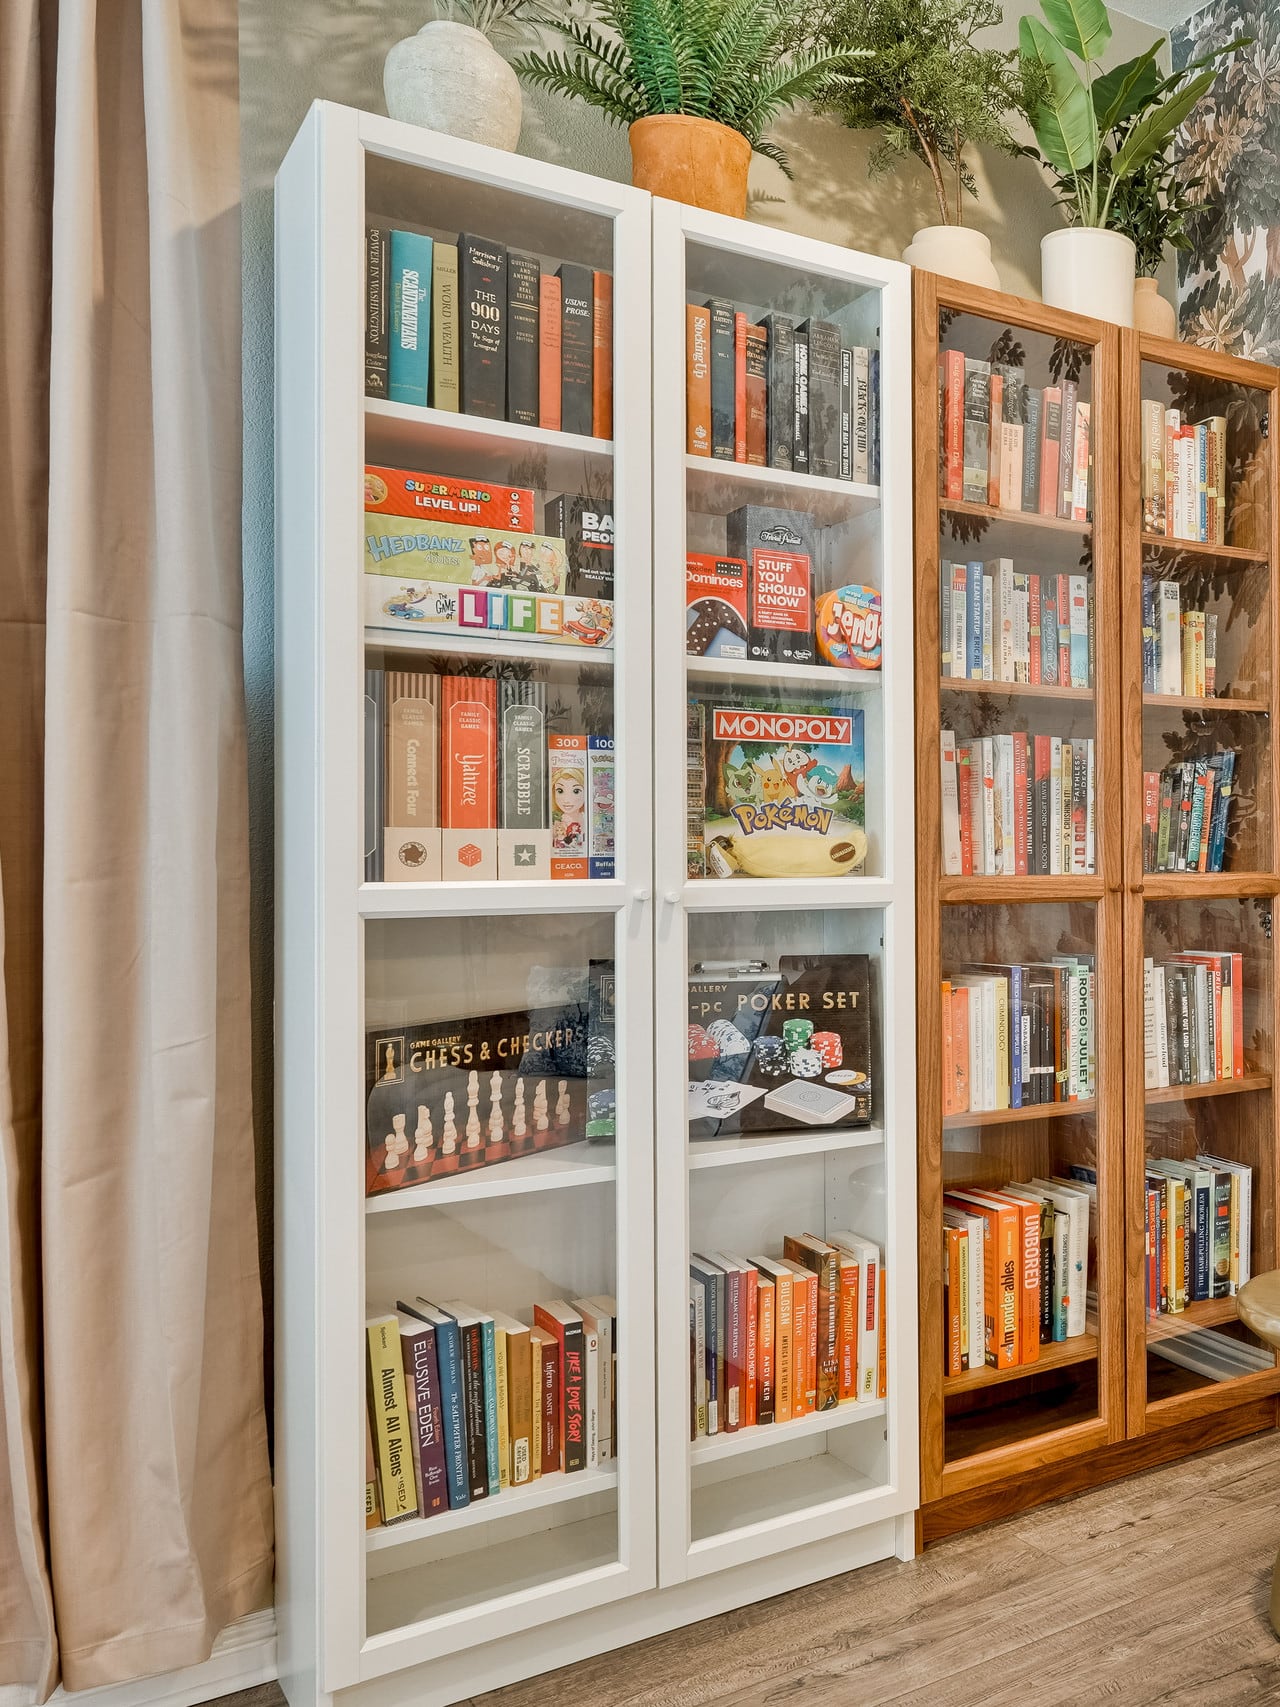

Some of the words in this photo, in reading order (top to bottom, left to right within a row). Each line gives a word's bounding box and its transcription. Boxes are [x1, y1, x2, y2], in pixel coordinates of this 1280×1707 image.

[370, 230, 379, 263] POWER
[469, 247, 497, 261] Harrison
[370, 265, 379, 277] IN
[401, 269, 418, 351] SCANDINAVIANS
[442, 284, 452, 318] WORD
[475, 290, 496, 303] THE
[565, 298, 587, 307] USING
[370, 280, 379, 344] WASHINGTON
[471, 302, 499, 321] 900
[565, 307, 591, 318] PROSE:
[471, 320, 500, 335] DAYS
[694, 316, 707, 364] Stocking
[442, 321, 452, 366] WEALTH
[694, 364, 707, 379] Up
[1007, 370, 1017, 417] Michelangelo
[1152, 404, 1161, 435] Daniel
[1152, 438, 1161, 461] Silva
[405, 479, 448, 496] SUPER
[450, 488, 491, 502] MARIO
[415, 496, 456, 512] LEVEL
[459, 503, 481, 514] UP!
[582, 512, 614, 531] BA
[367, 534, 465, 563] HEDBANZ
[758, 560, 792, 572] STUFF
[758, 571, 784, 583] YOU
[438, 592, 448, 601] The
[758, 583, 806, 597] SHOULD
[758, 594, 798, 607] KNOW
[952, 583, 965, 591] LIVE
[435, 599, 456, 613] GAME
[445, 611, 453, 620] OF
[462, 592, 562, 631] LIFE
[1032, 594, 1040, 626] Editor
[719, 715, 849, 740] MONOPOLY
[556, 739, 579, 747] 300
[407, 740, 420, 787] Connect
[455, 753, 484, 806] Yahtzee
[517, 747, 530, 815] SCRABBLE
[407, 791, 420, 816] Four
[1191, 812, 1202, 851] GARDENER
[737, 993, 810, 1011] POKER
[822, 992, 860, 1009] SET
[1079, 978, 1088, 1026] ROMEO
[410, 1040, 430, 1049] GAME
[432, 1036, 461, 1047] GALLERY
[410, 1046, 473, 1073] CHESS
[480, 1041, 490, 1060] &
[497, 1027, 589, 1058] CHECKERS
[1079, 1038, 1088, 1084] JULIET
[1024, 1214, 1039, 1289] UNBORED
[780, 1281, 790, 1325] BULOSAN
[976, 1285, 981, 1295] MY
[1000, 1260, 1016, 1346] Imponderables
[795, 1304, 806, 1336] Thrive
[843, 1295, 853, 1343] SYMPATHIZER
[566, 1352, 581, 1374] LIKE
[749, 1349, 755, 1360] NO
[413, 1341, 431, 1402] ELUSIVE
[545, 1361, 555, 1388] Inferno
[381, 1368, 398, 1409] Almost
[567, 1386, 582, 1411] LOVE
[386, 1417, 400, 1433] All
[418, 1406, 434, 1447] EDEN
[451, 1405, 461, 1450] SALTWATER
[566, 1413, 582, 1442] STORY
[388, 1439, 404, 1477] Aliens
[455, 1451, 464, 1486] FRONTIER
